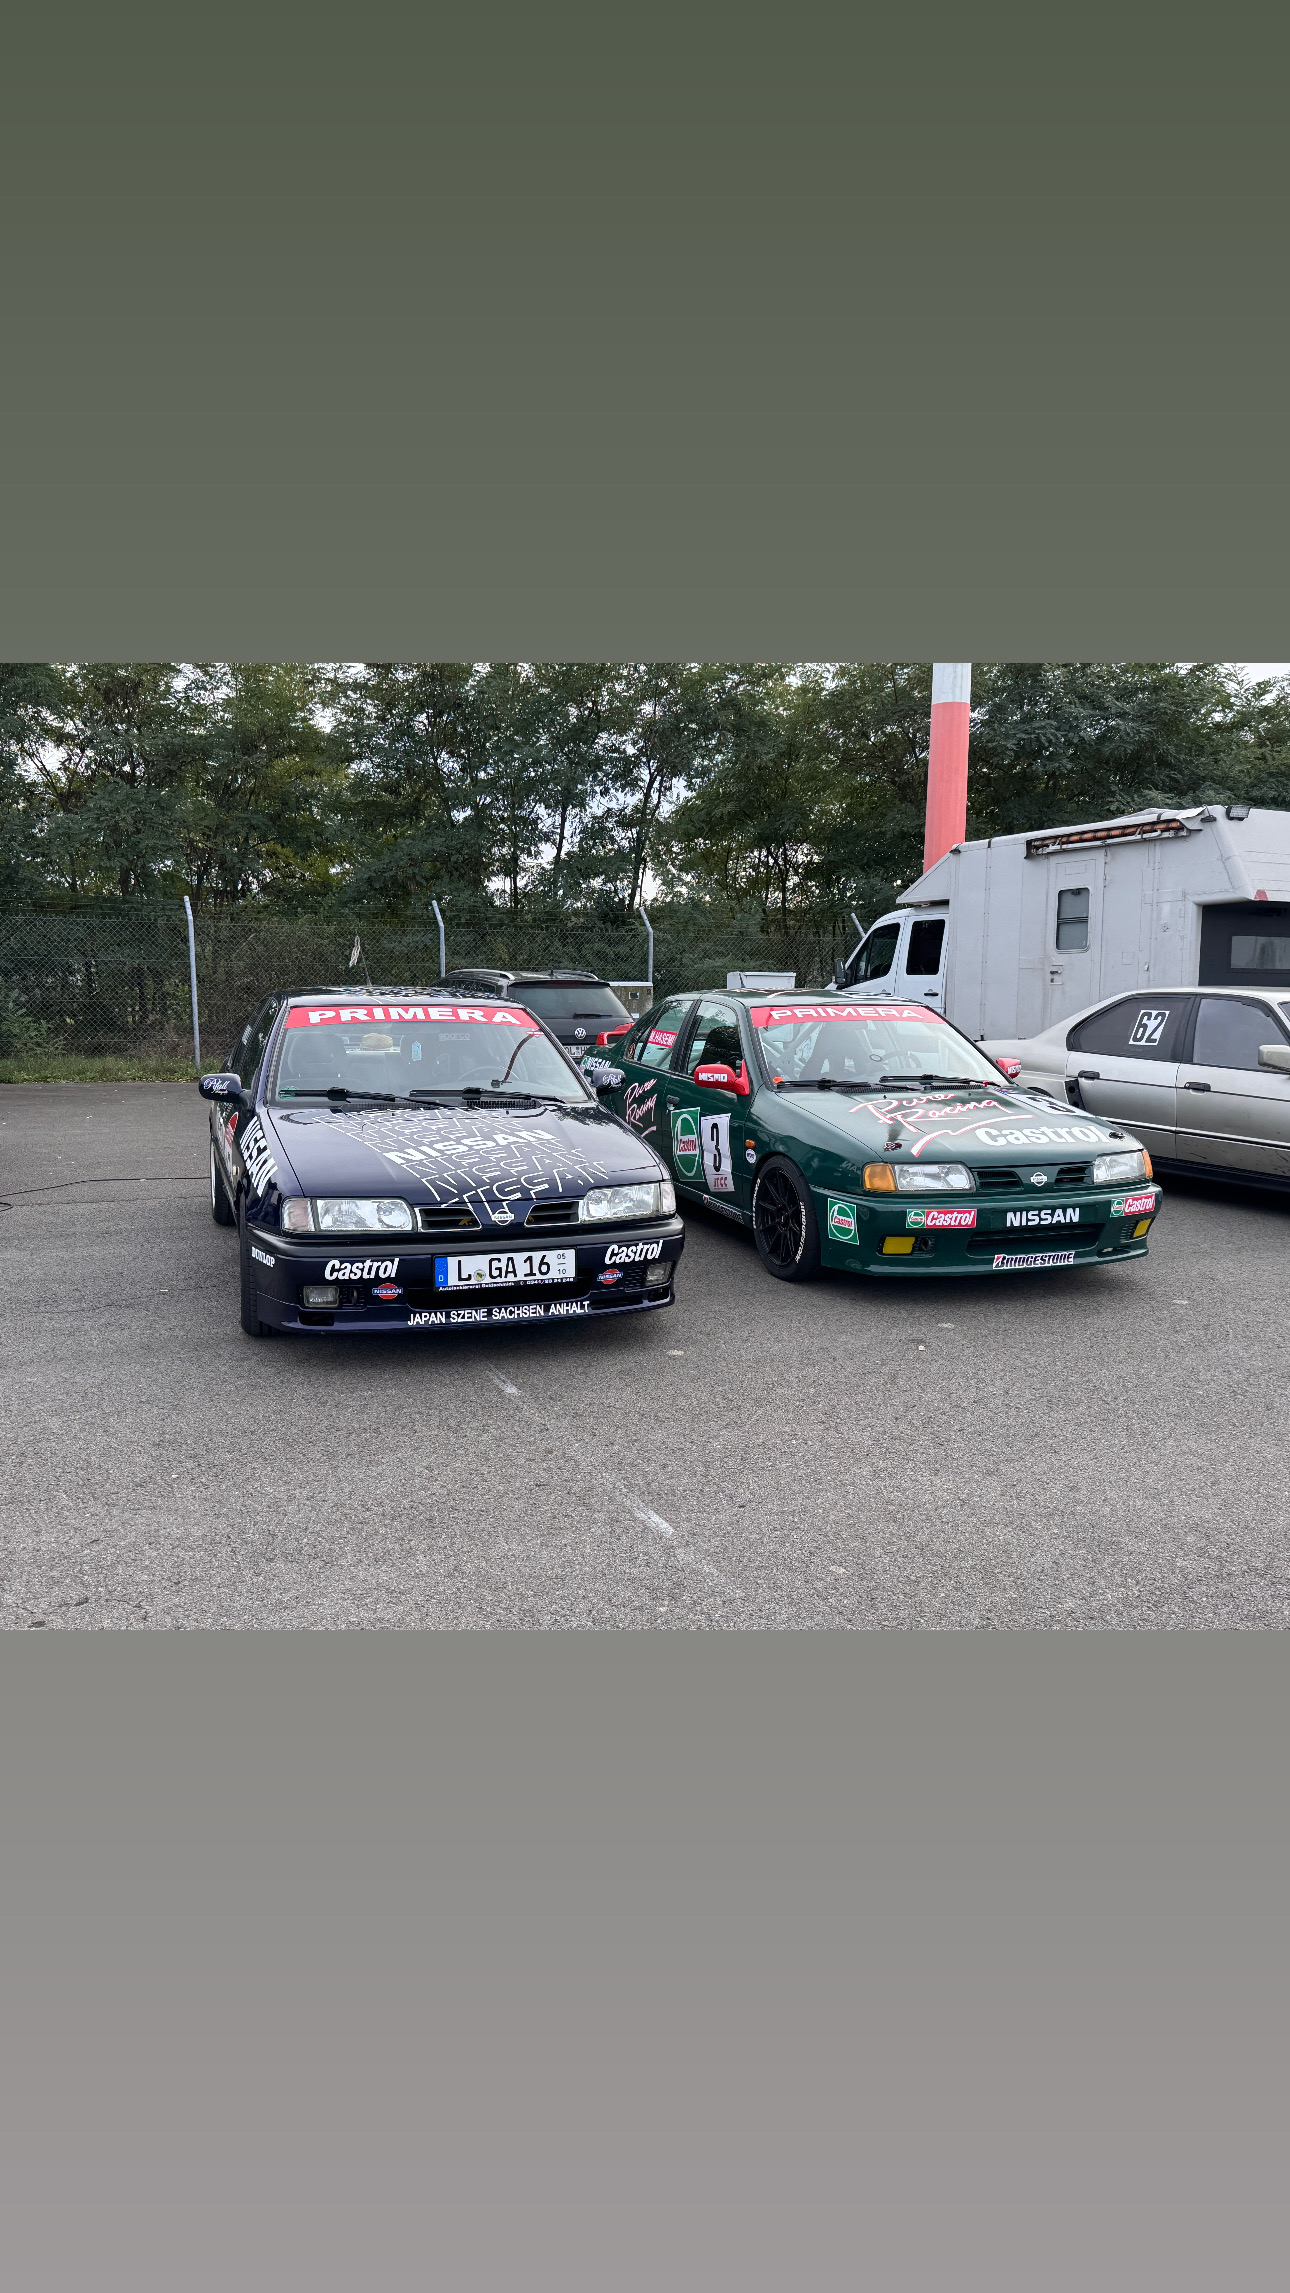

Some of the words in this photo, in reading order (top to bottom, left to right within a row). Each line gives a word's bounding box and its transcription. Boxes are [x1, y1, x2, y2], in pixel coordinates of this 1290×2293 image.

[307, 1006, 522, 1025] PRIMERA
[770, 1007, 925, 1020] PRIMERA
[1131, 1011, 1167, 1043] 62
[698, 1072, 728, 1083] NISMO
[849, 1093, 957, 1125] Pure
[678, 1137, 697, 1153] Castrol
[975, 1125, 1112, 1147] Castrol
[239, 1116, 279, 1198] NISSAN
[383, 1130, 557, 1165] NISSAN
[710, 1122, 722, 1173] 3
[1125, 1196, 1155, 1213] Castrol
[833, 1216, 853, 1228] Castrol
[926, 1210, 976, 1227] Castrol
[1006, 1207, 1080, 1228] NISSAN
[251, 1246, 276, 1268] DUNLOP
[604, 1240, 664, 1265] Castrol
[993, 1251, 1076, 1270] BRIDGESTONE
[324, 1257, 400, 1281] Castrol
[438, 1274, 444, 1282] D
[457, 1259, 472, 1282] L
[488, 1256, 518, 1280] GA
[523, 1254, 551, 1278] 16
[373, 1287, 403, 1295] NISSAN
[407, 1311, 446, 1326] JAPAN
[450, 1308, 488, 1323] SZENE
[491, 1304, 545, 1320] SACHSEN
[548, 1300, 590, 1316] ANHALT
